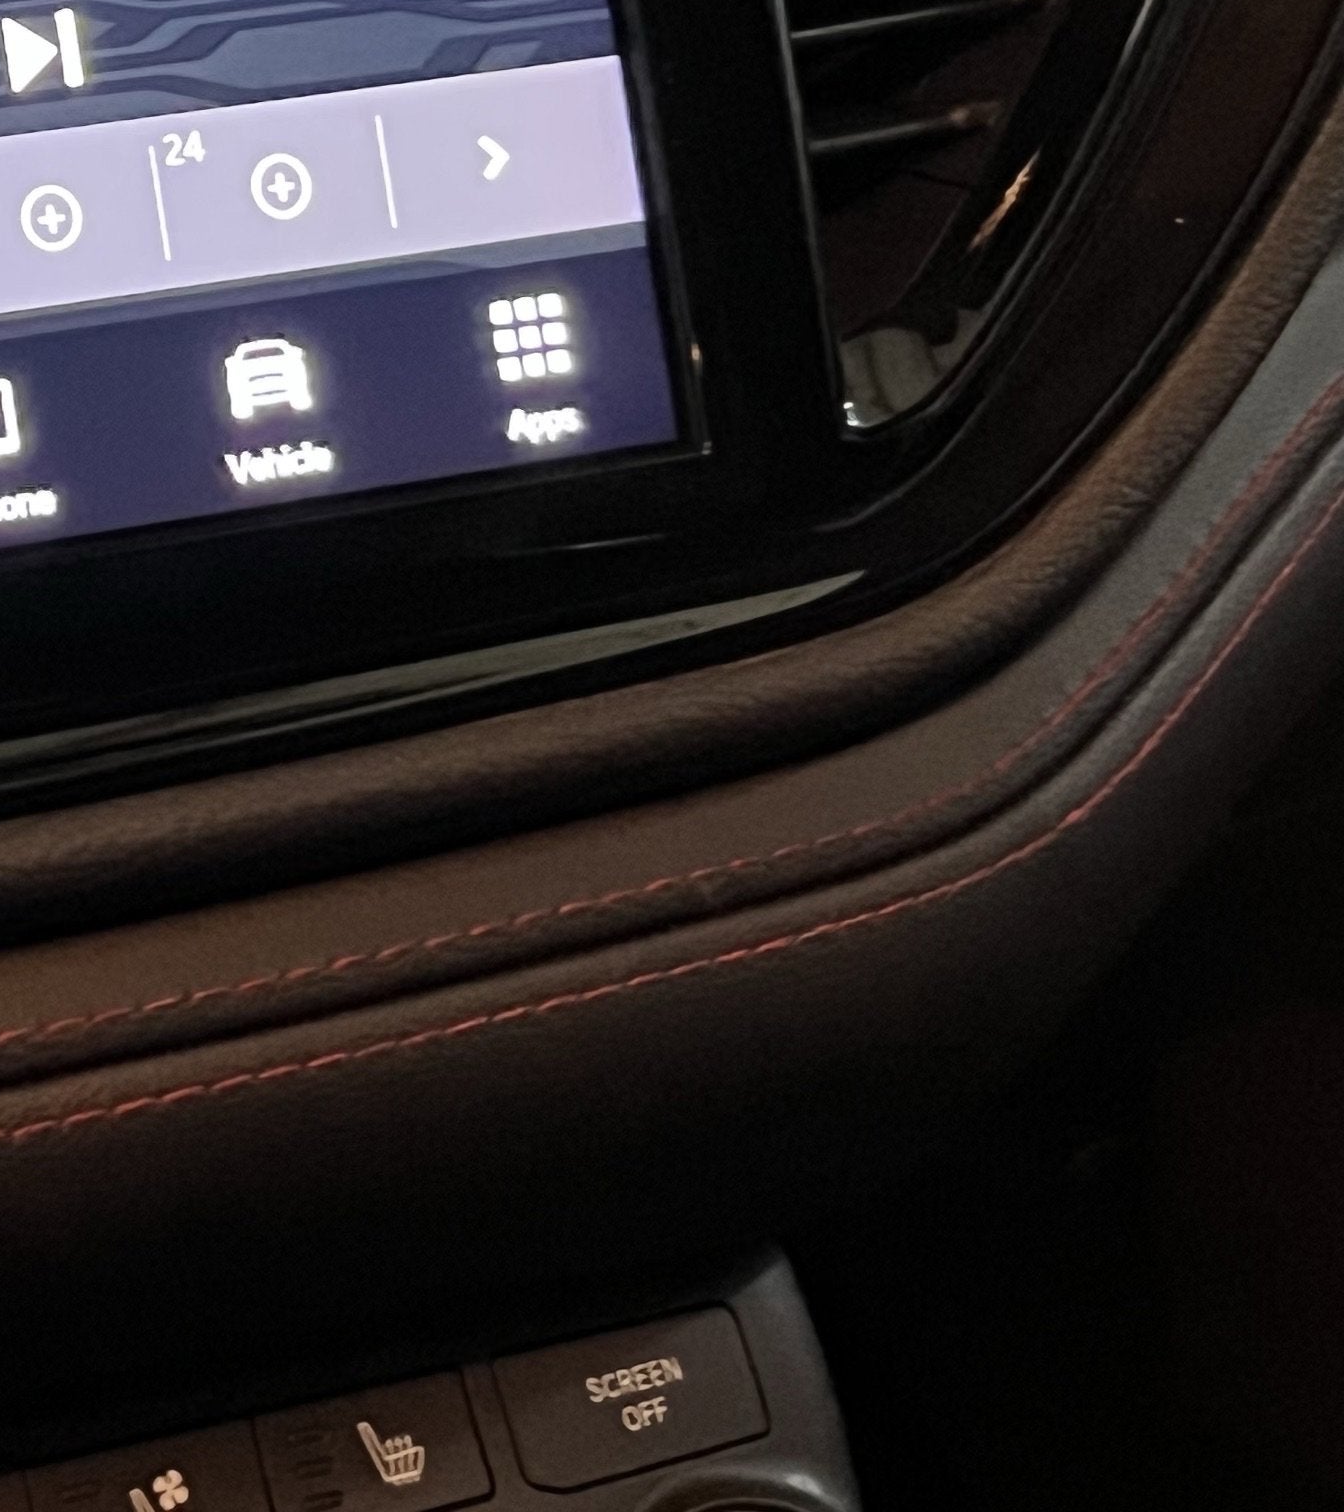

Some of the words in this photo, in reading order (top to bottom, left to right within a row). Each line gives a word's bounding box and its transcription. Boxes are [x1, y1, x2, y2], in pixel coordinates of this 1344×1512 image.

[160, 132, 206, 169] 24
[506, 406, 582, 446] Apps
[224, 443, 332, 486] Vehicle
[585, 1357, 683, 1402] SCREEN
[620, 1396, 669, 1431] OFF
